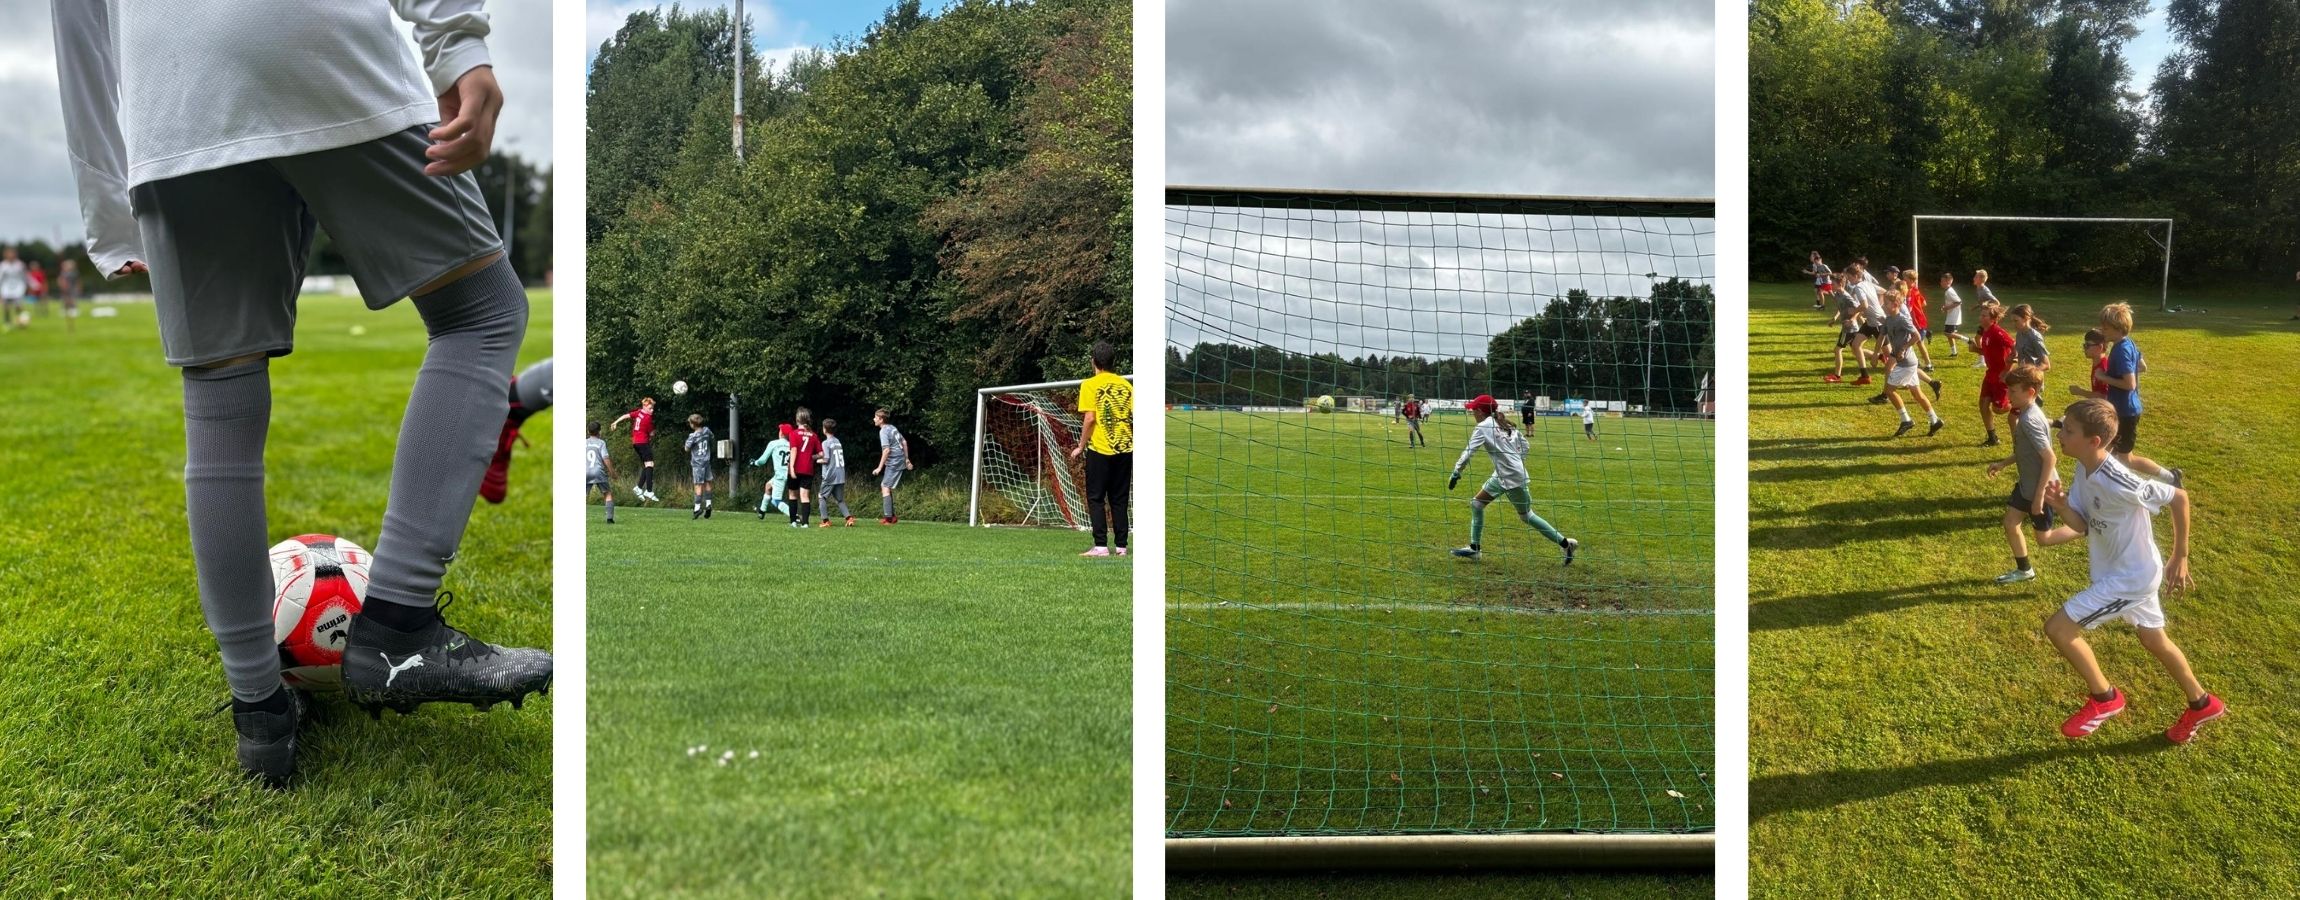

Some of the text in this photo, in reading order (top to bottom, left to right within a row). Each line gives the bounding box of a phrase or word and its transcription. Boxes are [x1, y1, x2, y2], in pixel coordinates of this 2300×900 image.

[697, 439, 708, 456] 10
[800, 436, 809, 453] 7
[587, 449, 596, 468] 9
[833, 448, 845, 468] 15
[316, 614, 347, 633] erima
